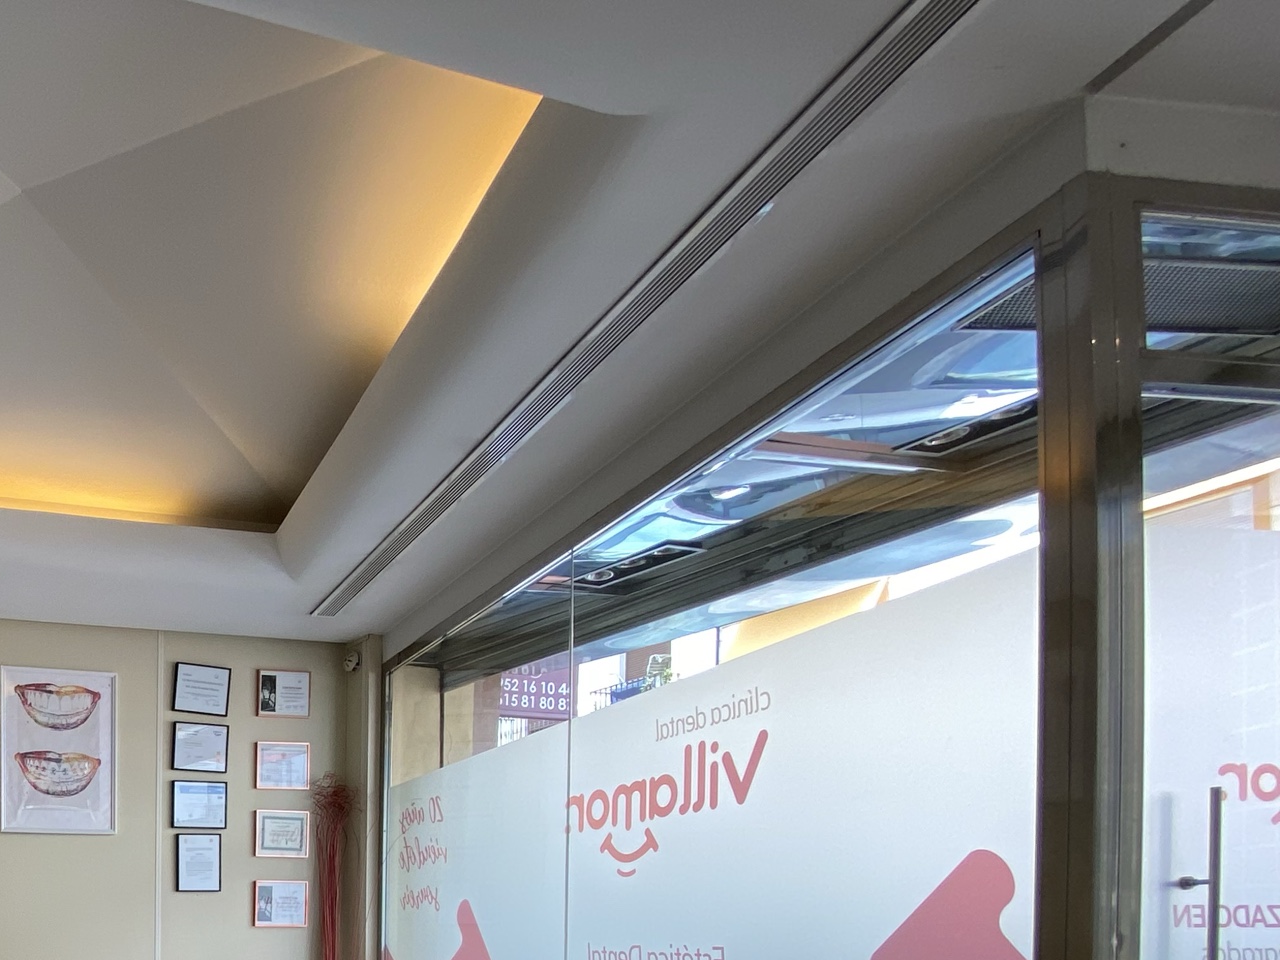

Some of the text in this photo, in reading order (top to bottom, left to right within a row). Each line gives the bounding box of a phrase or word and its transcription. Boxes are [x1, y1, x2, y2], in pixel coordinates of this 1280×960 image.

[501, 678, 519, 692] 52
[523, 680, 537, 693] 16
[541, 681, 555, 695] 10
[521, 695, 535, 708] 81
[539, 696, 555, 710] 80
[558, 698, 570, 711] 8
